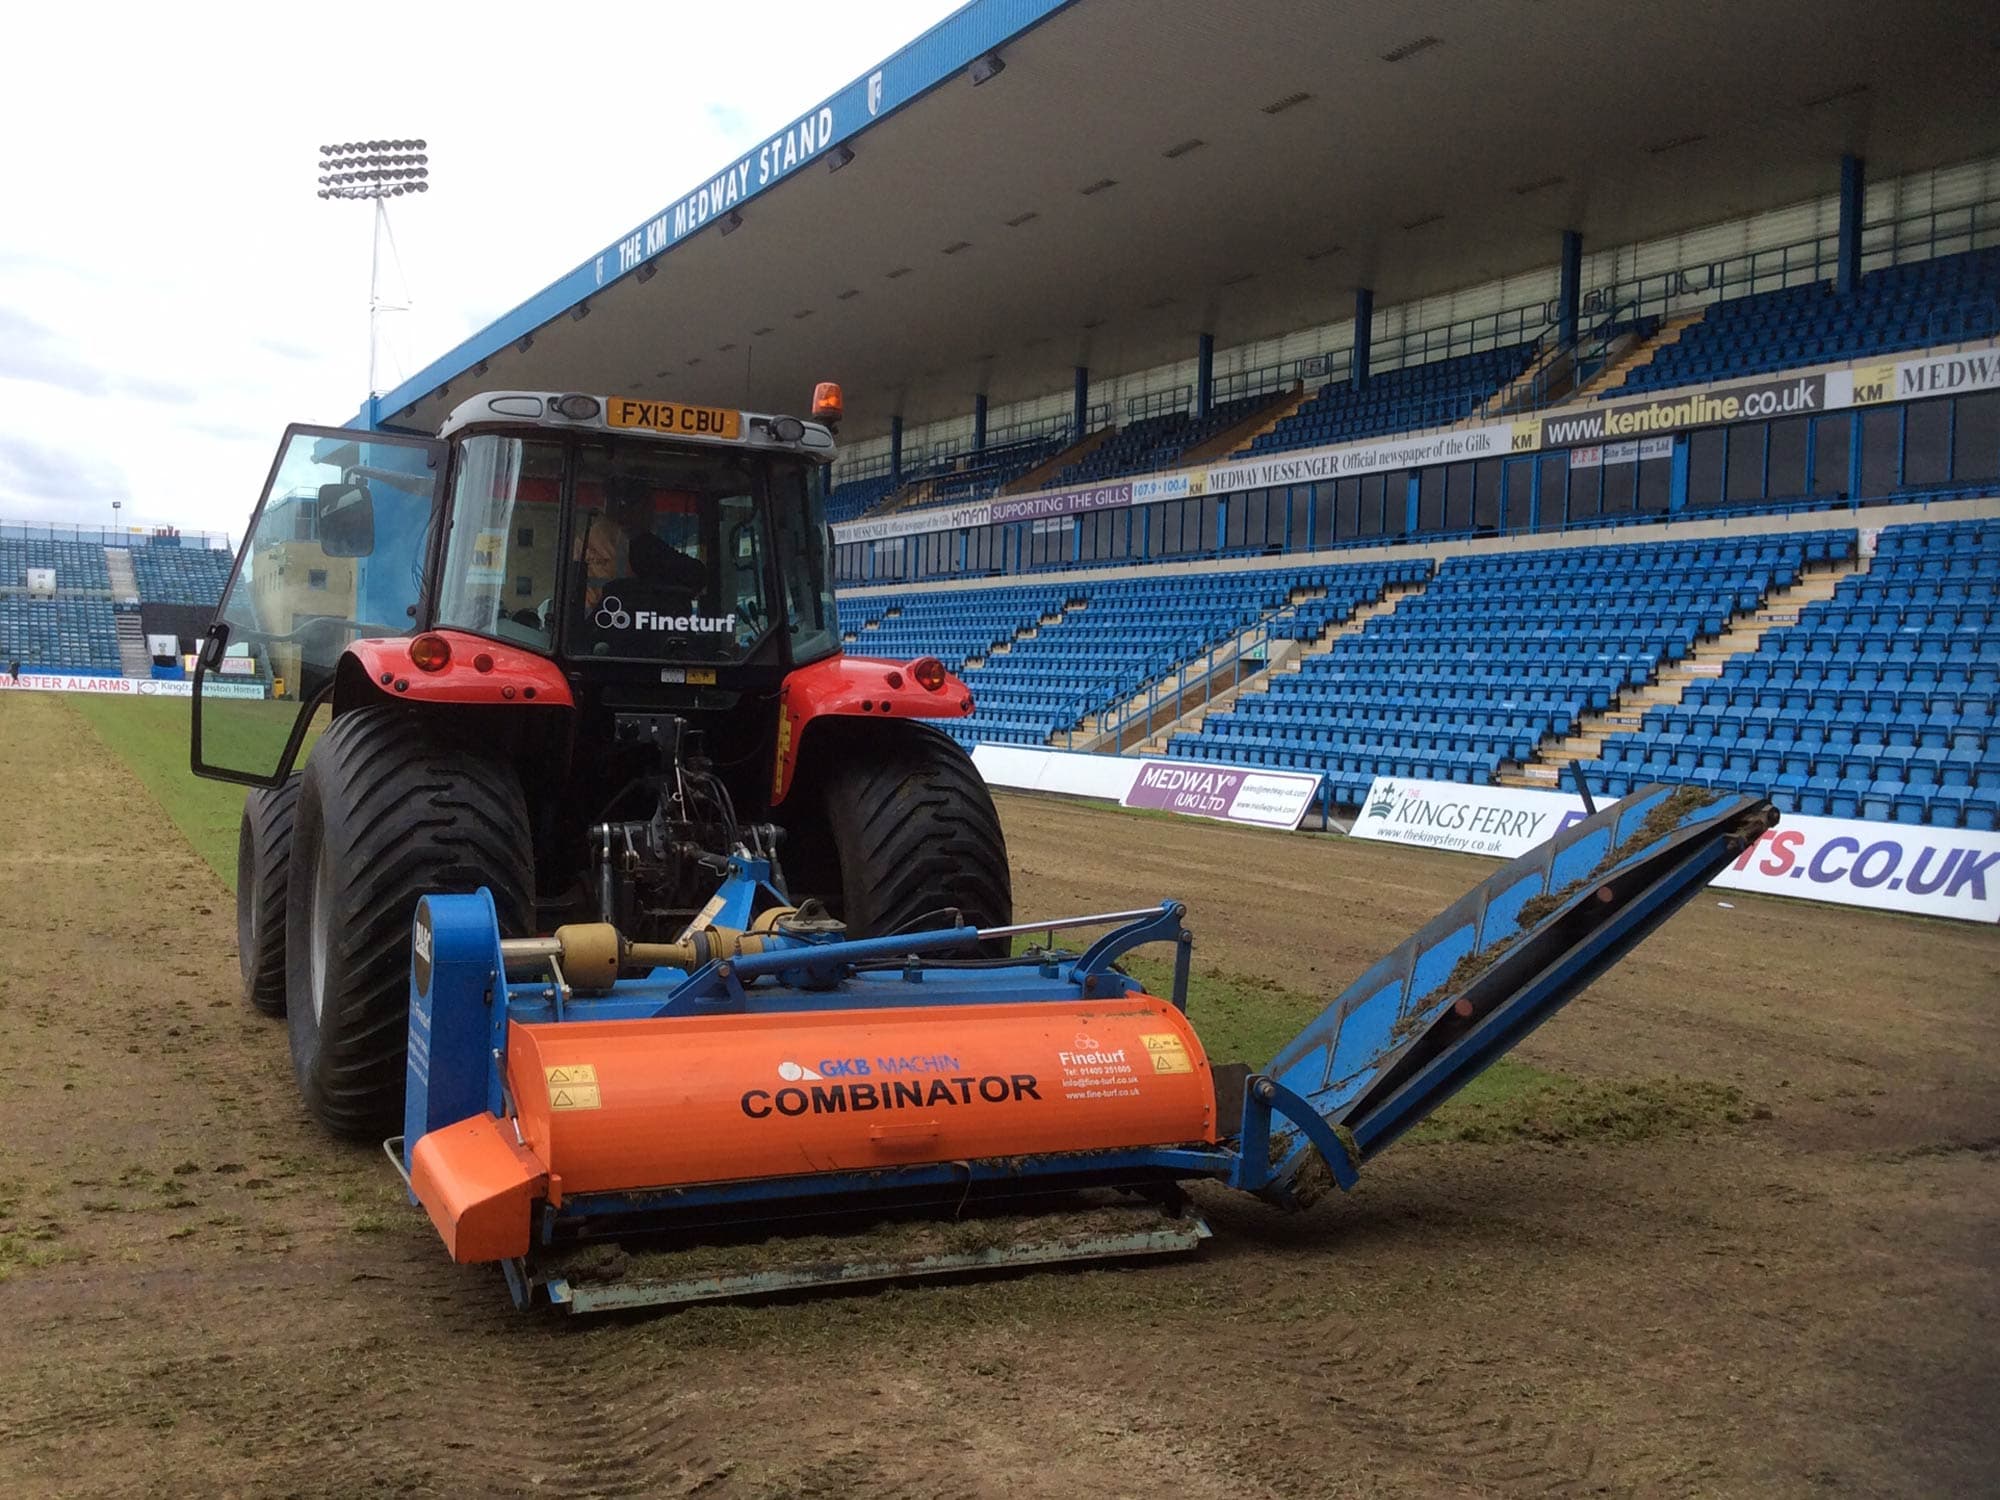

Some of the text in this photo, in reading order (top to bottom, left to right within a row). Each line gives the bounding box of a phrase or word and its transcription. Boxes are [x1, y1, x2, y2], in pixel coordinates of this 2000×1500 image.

[619, 107, 833, 271] THE KM MEDWAY STAND
[1851, 384, 1883, 403] KM
[621, 402, 725, 433] FX13 CBU
[1547, 379, 1815, 444] www.kentonline.co.uk
[1511, 434, 1532, 450] KM
[1210, 434, 1491, 491] MEDWAY MESSENGER Official newspaper of the Gills
[1134, 482, 1157, 497] 107.9
[993, 497, 1063, 519] SUPPORTING
[1067, 492, 1092, 509] THE
[1095, 486, 1129, 505] GILLS
[635, 611, 735, 632] Fineturf
[0, 675, 130, 693] MASTER ALARMS
[1141, 768, 1230, 794] MEDWAY
[1174, 792, 1226, 811] (UK) LTD
[1407, 788, 1421, 797] THE
[1395, 798, 1470, 829] KINGS
[1468, 806, 1547, 838] FERRY
[819, 1059, 871, 1077] GKB
[1059, 1050, 1126, 1065] Fineturf
[741, 1074, 1042, 1118] COMBINATOR
